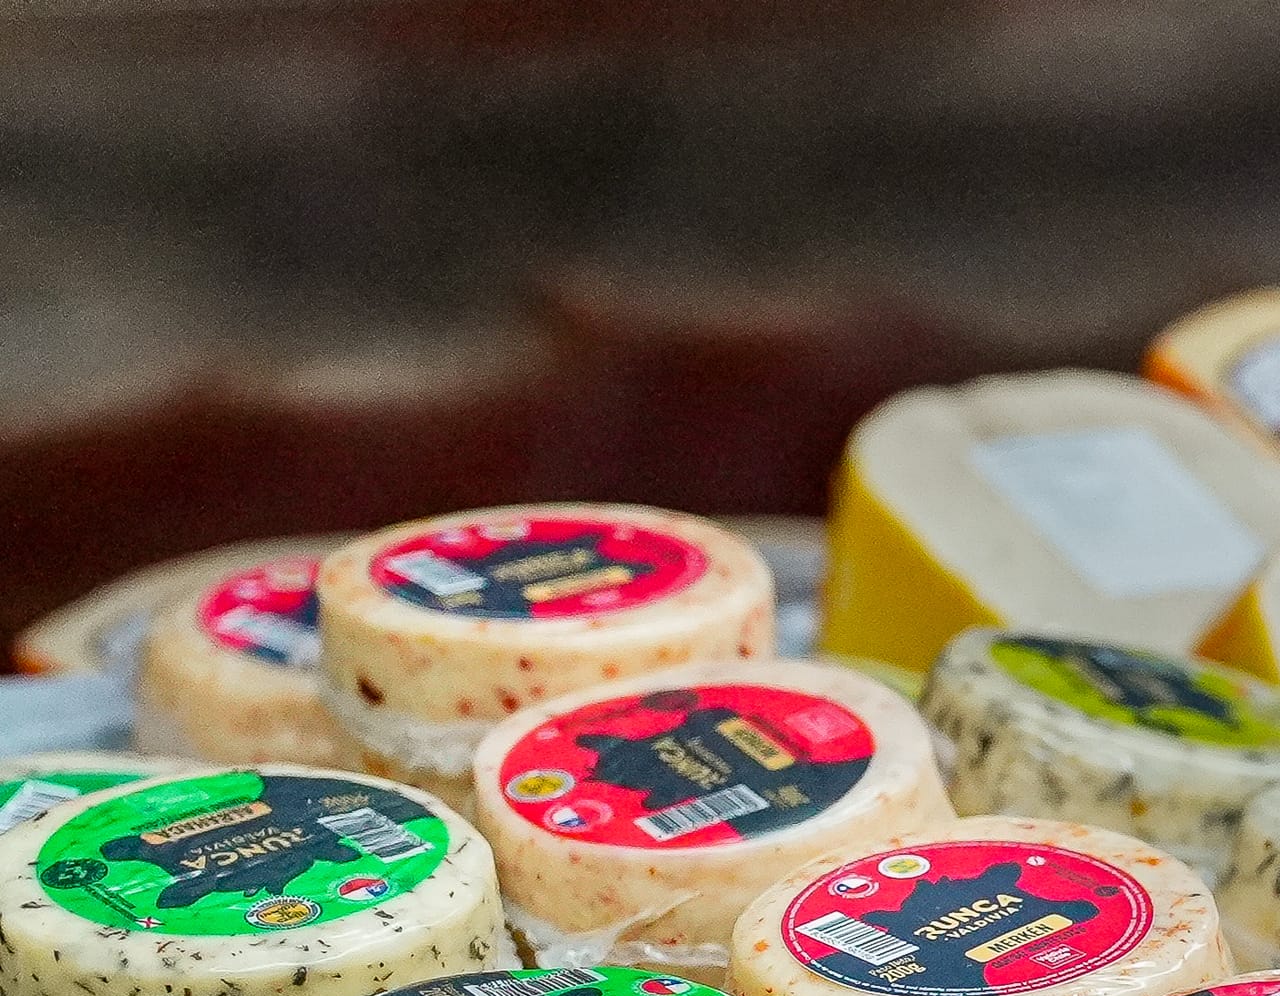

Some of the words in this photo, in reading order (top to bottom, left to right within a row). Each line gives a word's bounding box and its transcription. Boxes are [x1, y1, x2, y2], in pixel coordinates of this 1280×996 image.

[179, 827, 314, 870] RUNCA
[914, 894, 1023, 940] RUNCA
[947, 906, 1019, 938] VALDIVIA
[987, 924, 1053, 953] MERKÉN
[879, 962, 927, 983] 200g
